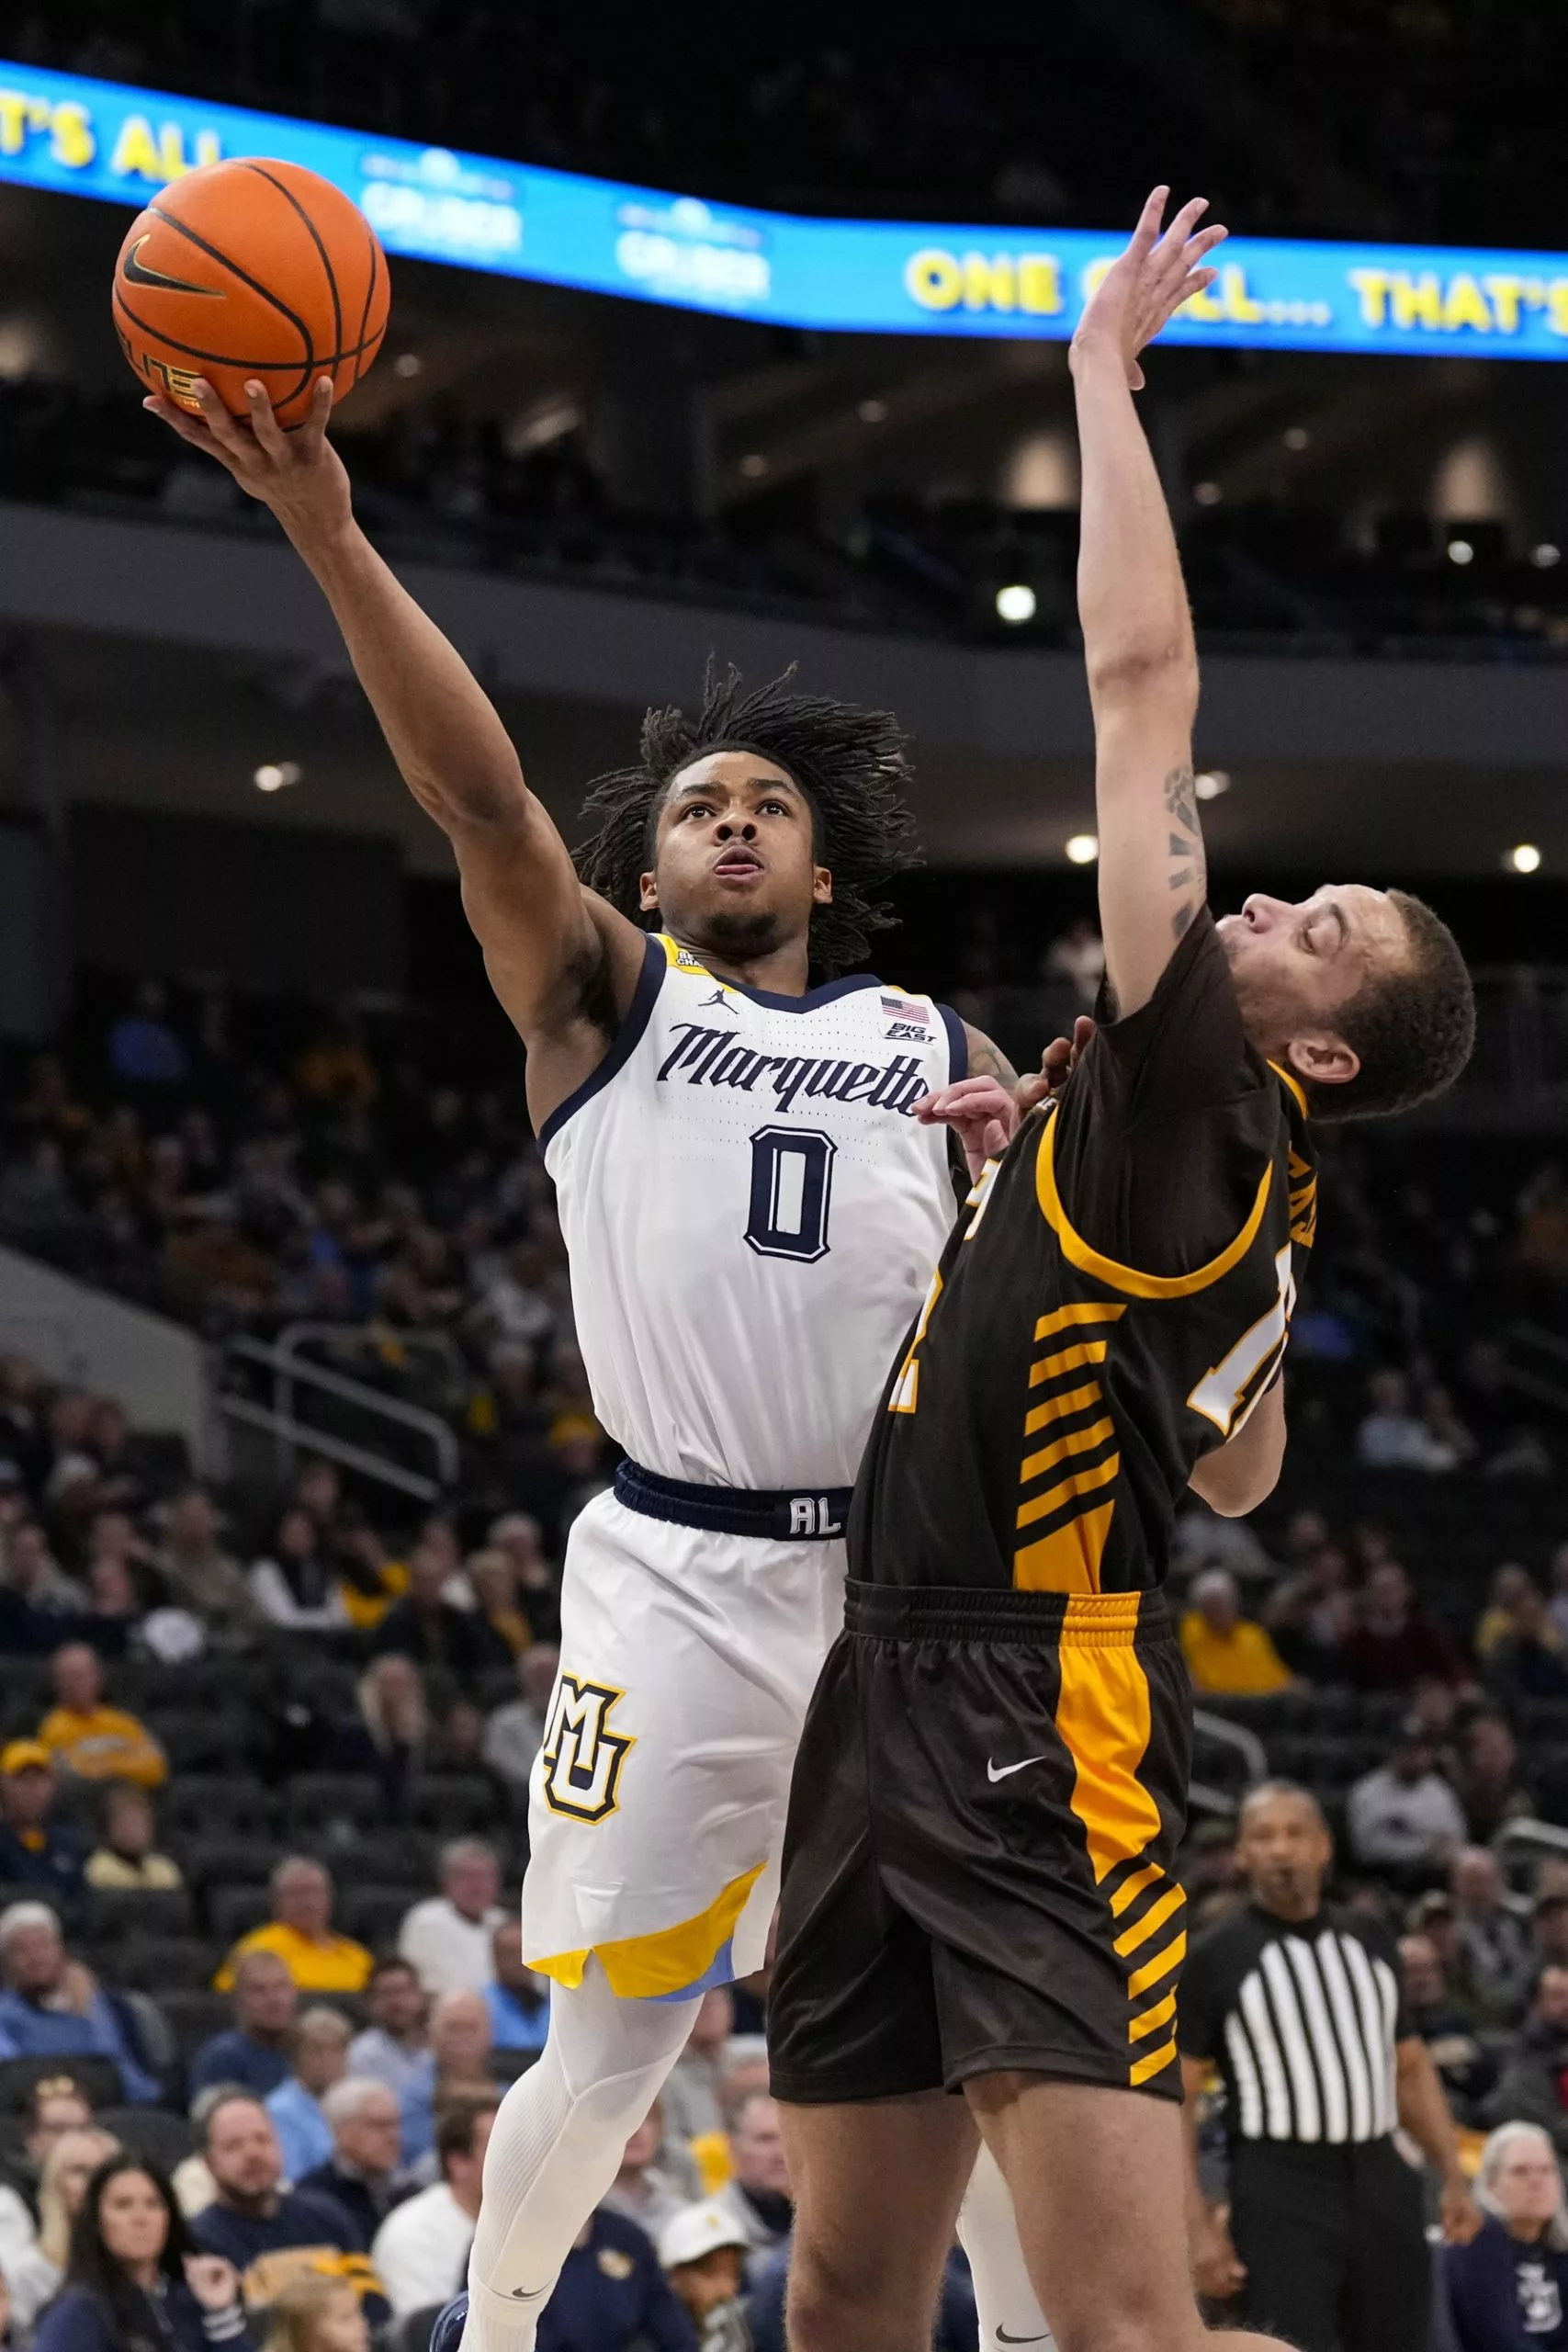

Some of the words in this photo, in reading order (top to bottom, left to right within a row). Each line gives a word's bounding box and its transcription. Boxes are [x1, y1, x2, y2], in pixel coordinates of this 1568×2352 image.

[905, 249, 1062, 315] ONE
[886, 1029, 937, 1043] EAST
[891, 1023, 926, 1035] BIG
[657, 1023, 930, 1117] Marquette
[742, 1124, 839, 1264] 0
[789, 1497, 841, 1535] AL
[543, 1671, 637, 1826] MU
